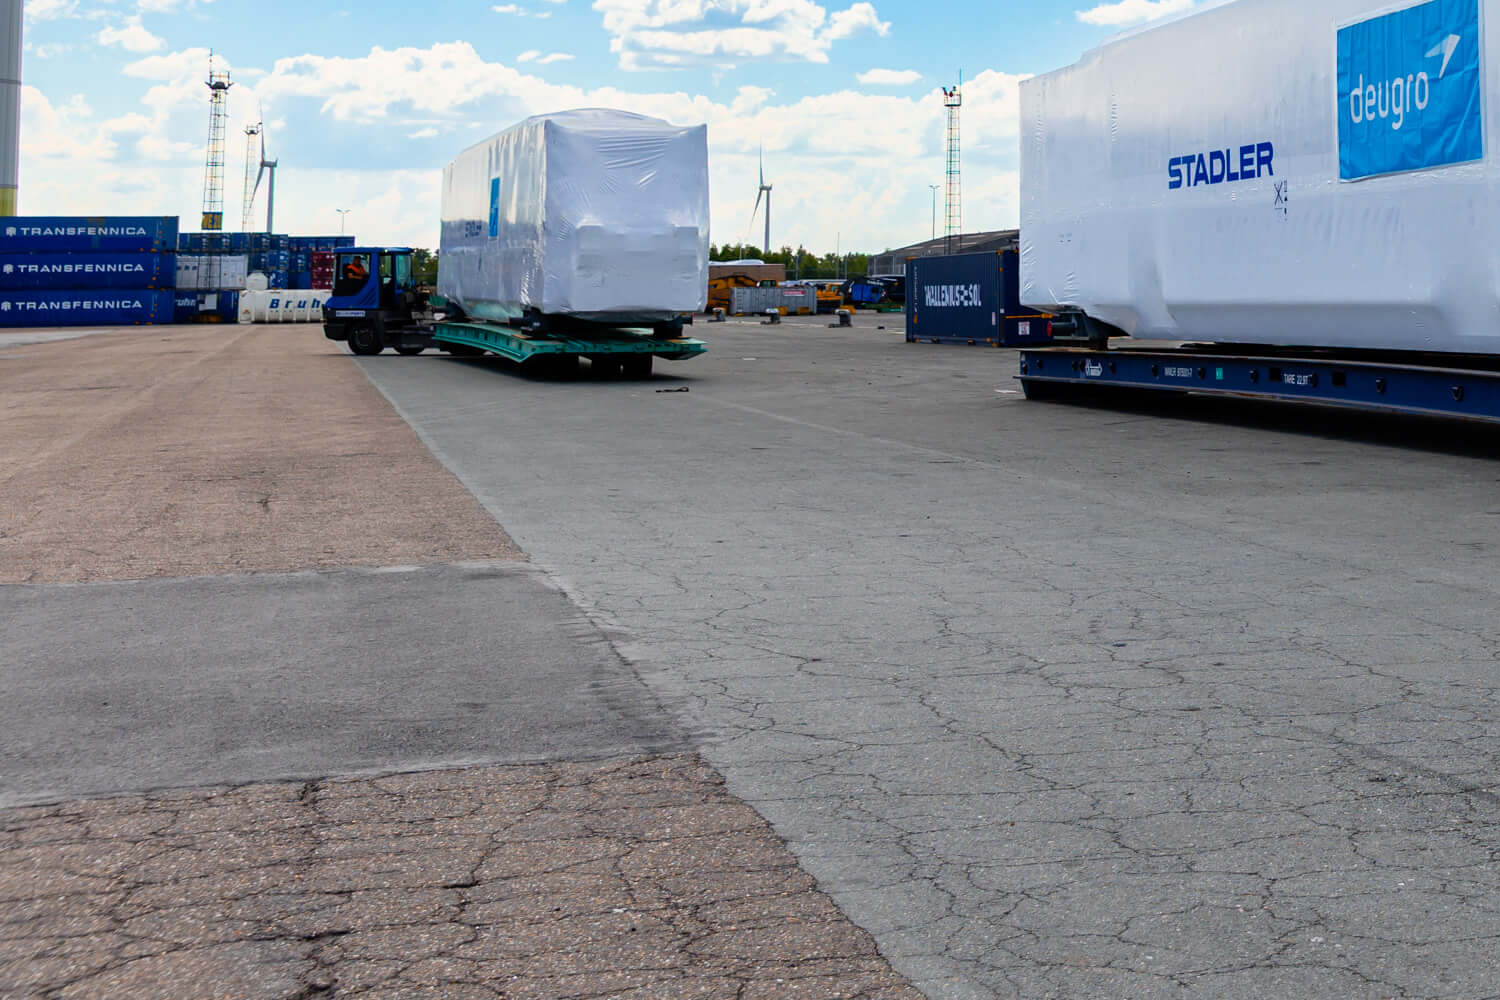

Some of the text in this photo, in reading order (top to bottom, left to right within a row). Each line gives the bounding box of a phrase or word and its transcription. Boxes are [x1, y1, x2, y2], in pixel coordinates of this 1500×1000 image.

[1349, 71, 1429, 130] deugro
[1168, 141, 1274, 190] STADLER
[20, 227, 147, 236] TRANSFENNICA
[17, 264, 145, 273] TRANSFENNICA
[924, 285, 960, 307] WALLENIUS
[15, 300, 143, 310] TRANSFENNICA
[174, 297, 197, 307] ruhn
[269, 298, 321, 309] Bruh
